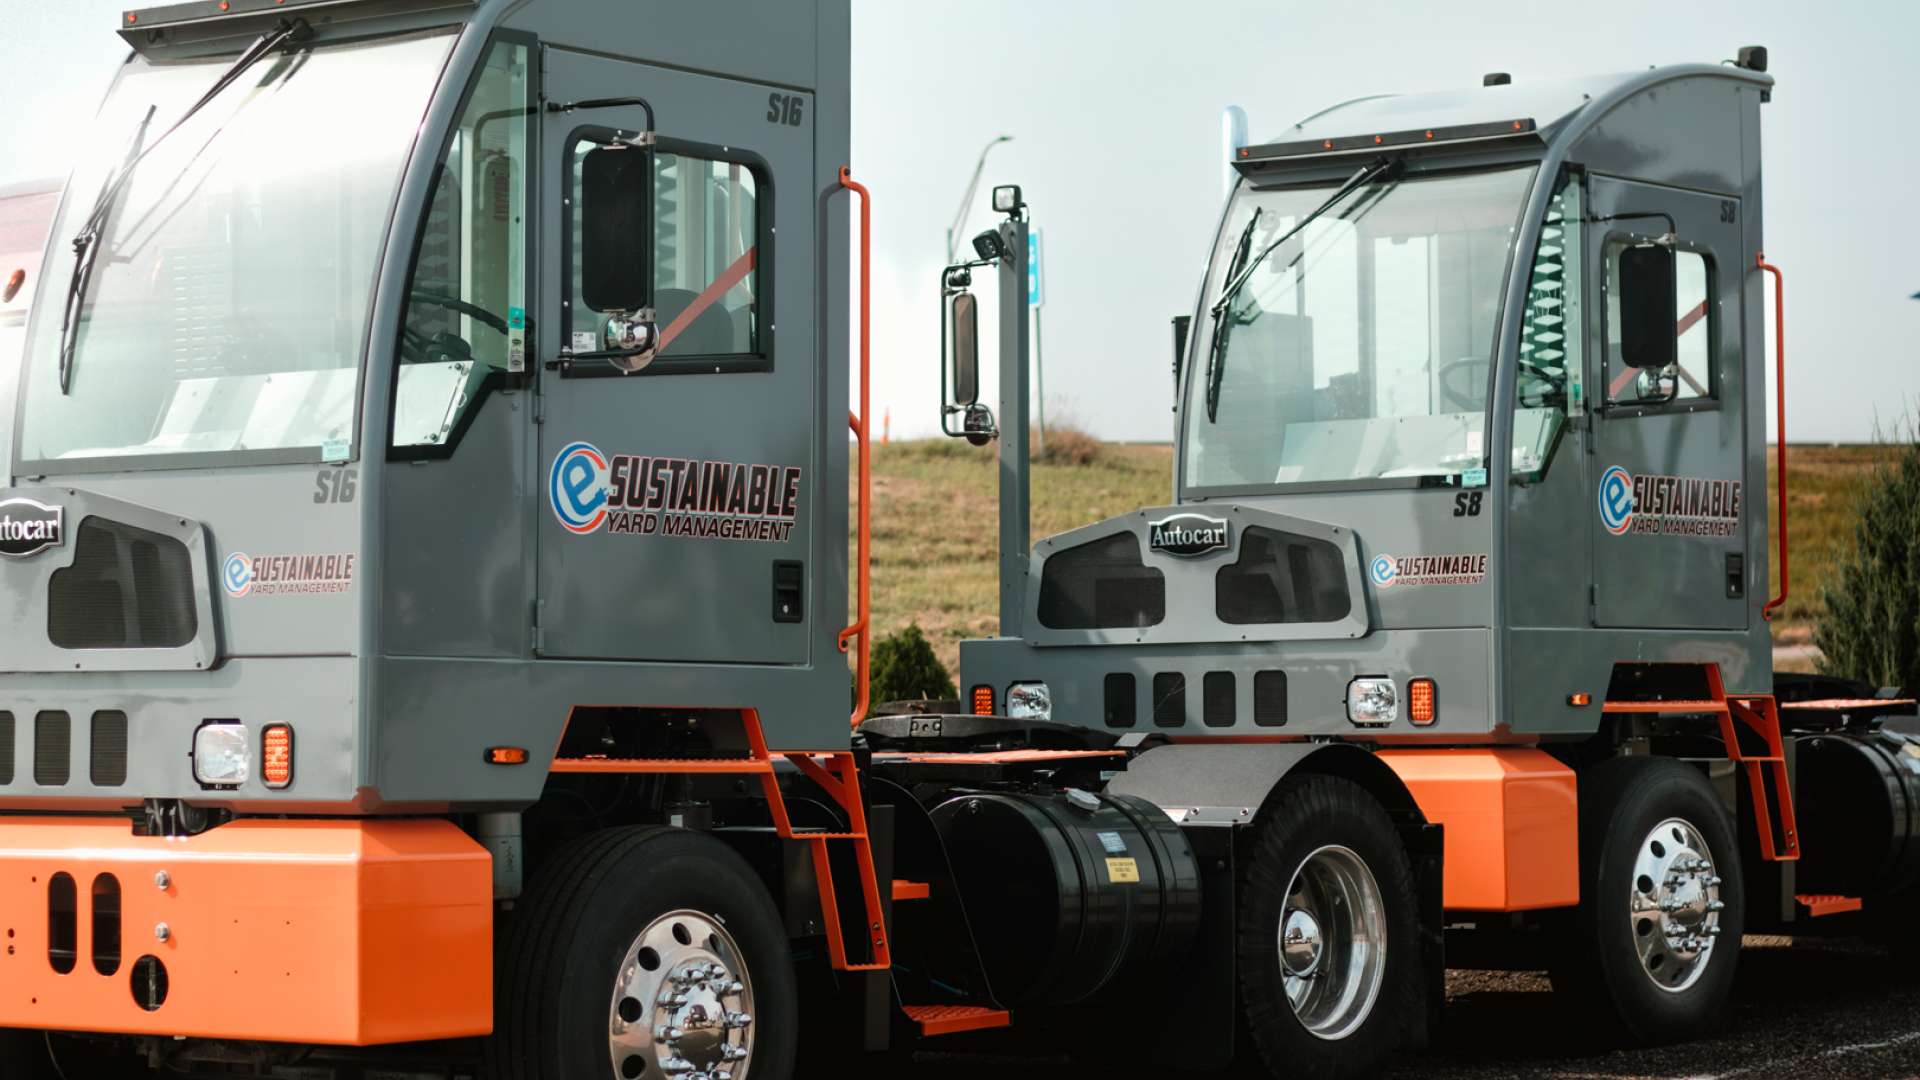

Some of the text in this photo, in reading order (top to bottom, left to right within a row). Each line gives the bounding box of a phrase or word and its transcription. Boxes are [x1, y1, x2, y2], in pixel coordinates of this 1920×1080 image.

[767, 92, 804, 127] S16
[1720, 199, 1737, 224] S8
[313, 470, 358, 504] S16
[607, 455, 801, 519] SUSTAINABLE
[1632, 475, 1742, 519] SUSTAINABLE
[1453, 491, 1483, 517] S8
[607, 512, 794, 542] YARD MANAGEMENT
[1151, 525, 1224, 546] Autocar
[1632, 519, 1738, 537] YARD MANAGEMENT
[251, 553, 355, 583] SUSTAINABLE
[1395, 554, 1487, 576] SUSTAINABLE
[251, 582, 352, 595] YARD MANAGEMENT
[1395, 575, 1483, 586] YARD MANAGEMENT
